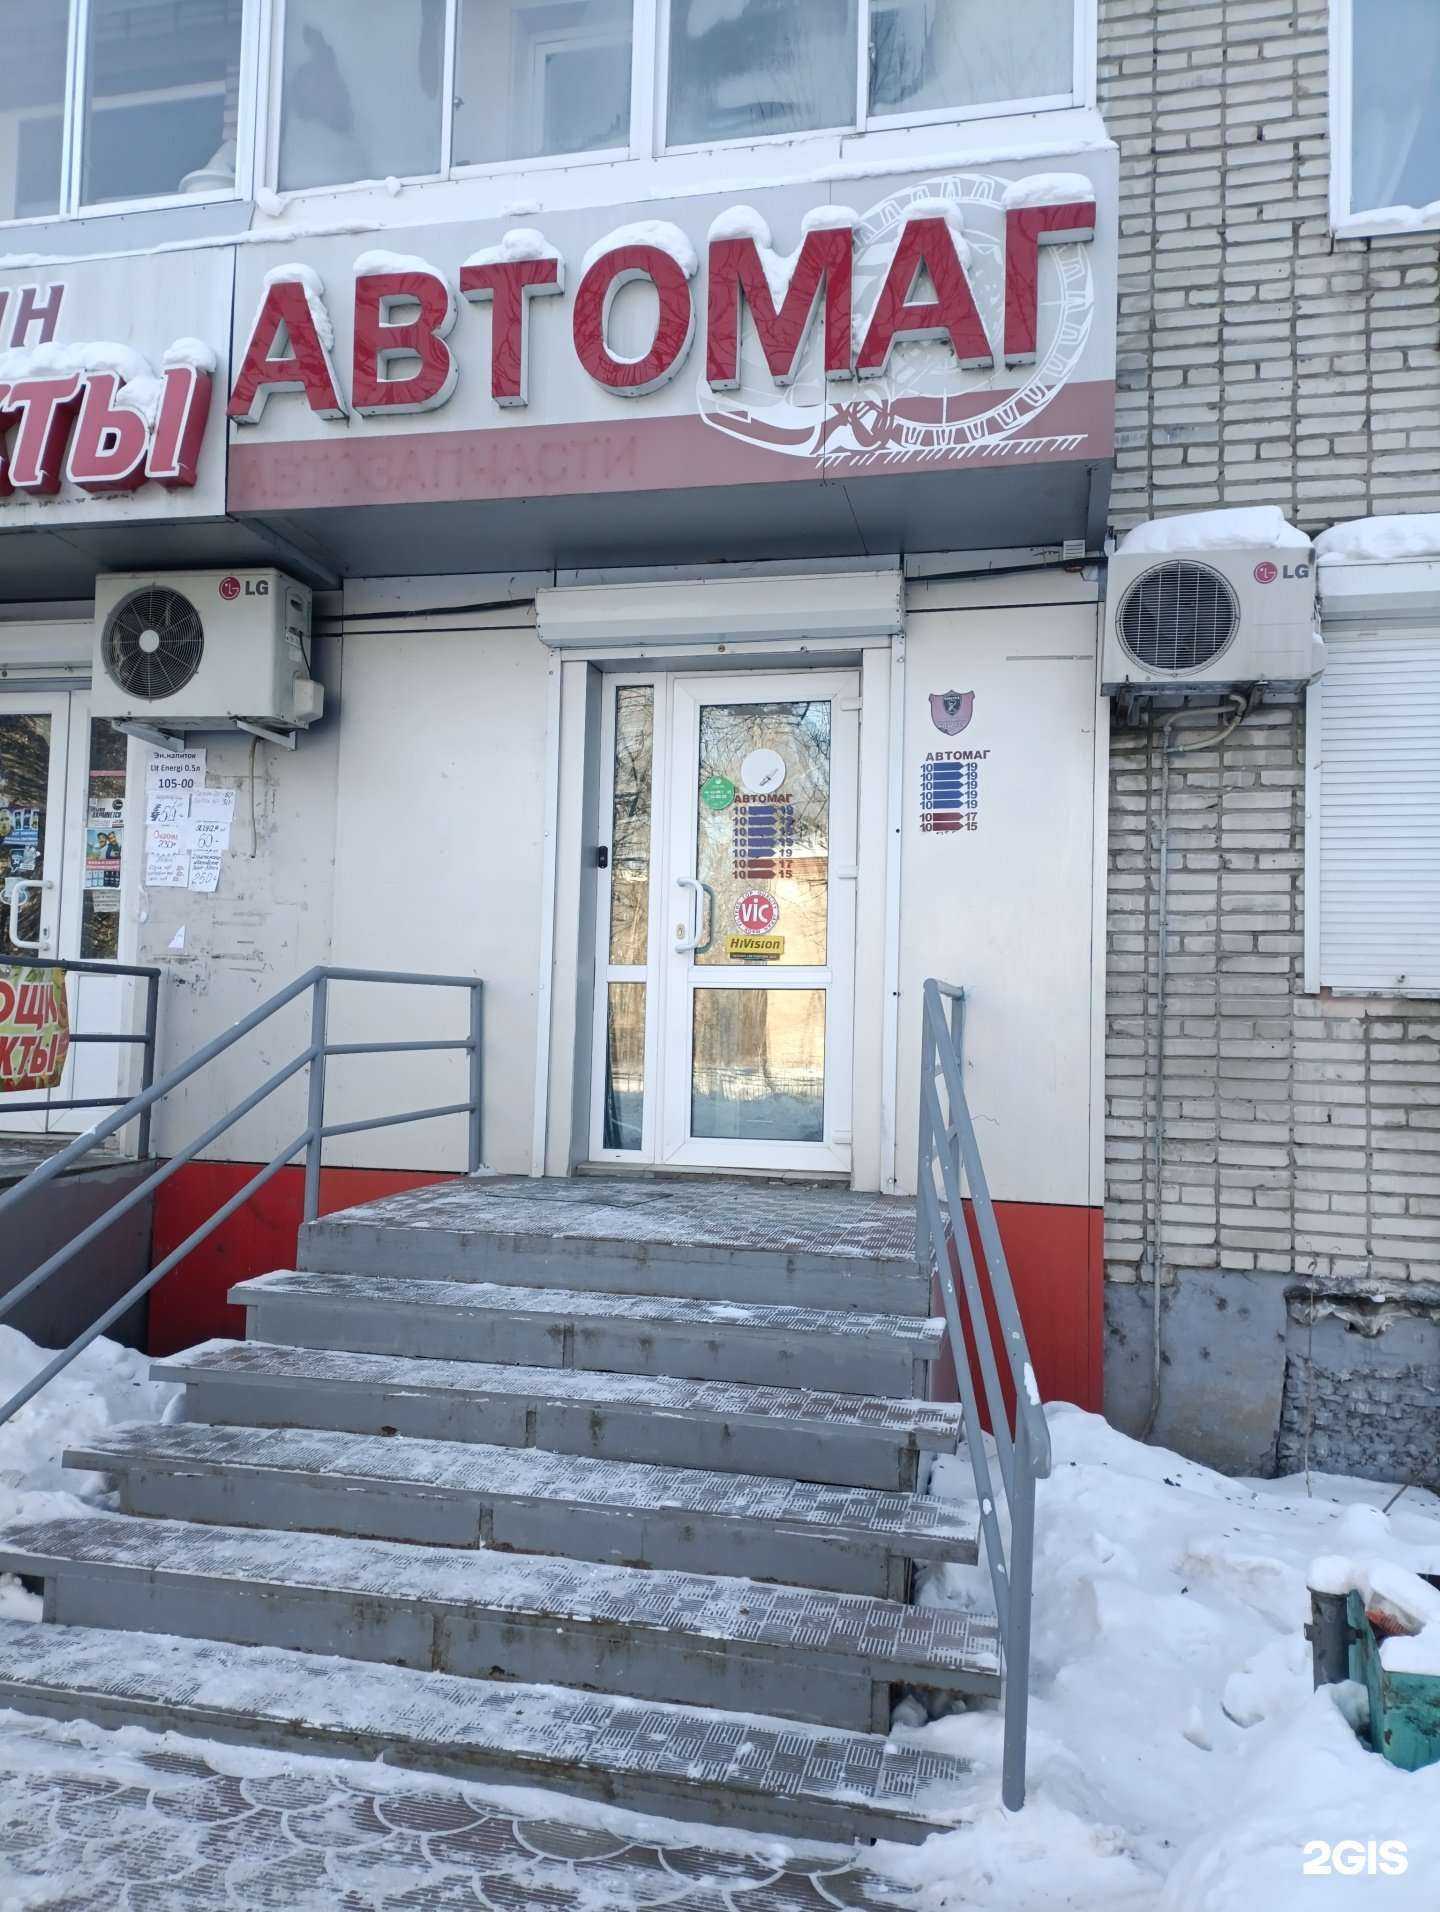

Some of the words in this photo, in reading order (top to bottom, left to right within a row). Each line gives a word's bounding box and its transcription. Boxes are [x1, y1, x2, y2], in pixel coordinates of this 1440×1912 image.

[0, 284, 65, 348] Н
[227, 200, 1096, 424] АВТОМАГ
[0, 364, 210, 488] ТЫ
[1283, 564, 1309, 579] LG
[245, 580, 269, 595] LG
[925, 749, 991, 761] АВТОМАГ
[920, 763, 933, 772] 10
[965, 762, 977, 771] 19
[920, 772, 933, 781] 10
[965, 771, 977, 780] 19
[158, 778, 194, 789] 105-00
[920, 781, 933, 791] 10
[965, 781, 977, 790] 19
[734, 794, 793, 803] АВТОМАГ
[920, 791, 933, 800] 10
[965, 790, 977, 799] 19
[920, 800, 933, 810] 10
[965, 800, 977, 809] 19
[732, 806, 747, 815] 10
[732, 817, 747, 825] 10
[920, 813, 933, 822] 10
[965, 812, 977, 821] 17
[732, 828, 747, 836] 10
[920, 823, 933, 832] 10
[965, 822, 977, 831] 15
[732, 838, 747, 847] 10
[732, 849, 747, 857] 10
[779, 849, 793, 857] 19
[732, 860, 747, 868] 10
[779, 859, 793, 868] 17
[732, 871, 747, 879] 10
[779, 870, 793, 878] 15
[730, 938, 780, 949] HiVision
